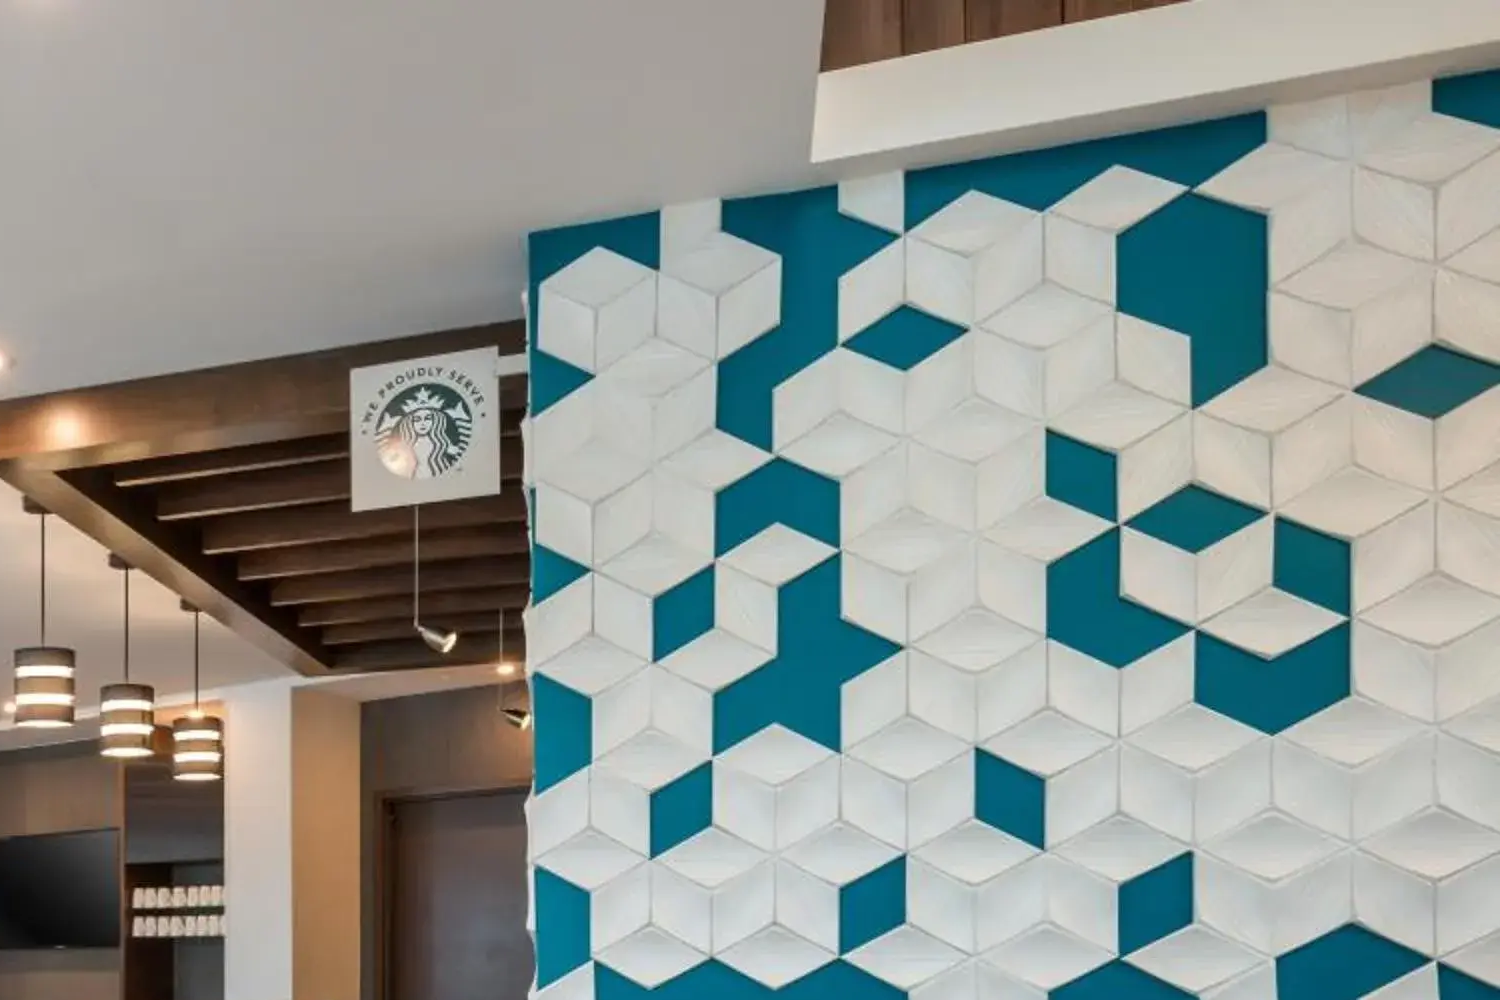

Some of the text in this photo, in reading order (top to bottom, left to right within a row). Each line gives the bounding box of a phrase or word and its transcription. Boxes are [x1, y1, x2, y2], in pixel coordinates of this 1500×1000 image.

[363, 367, 485, 423] WE PROUDLY SERVE
